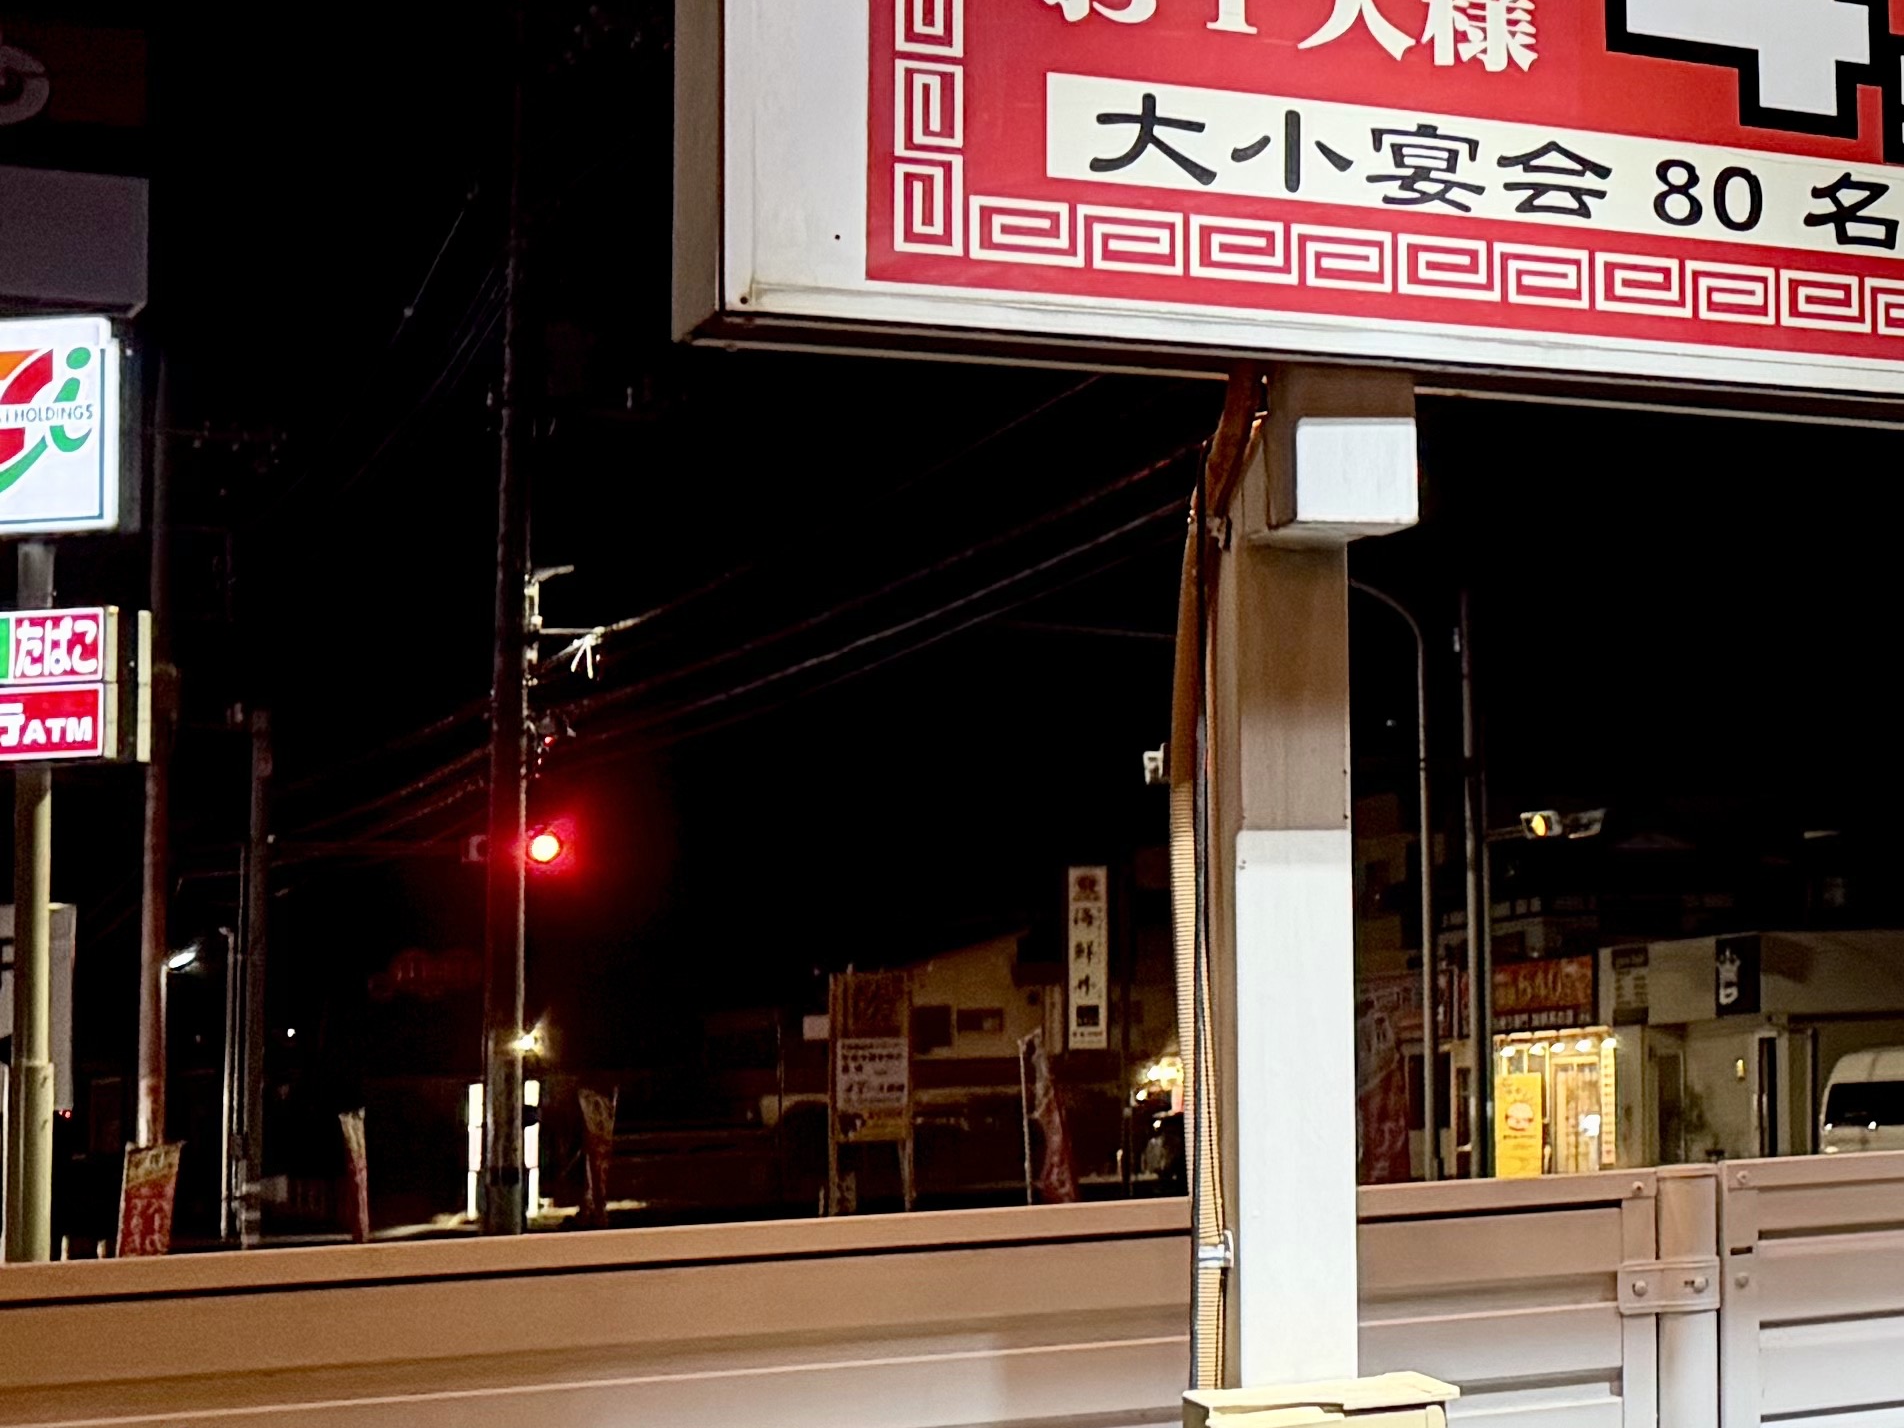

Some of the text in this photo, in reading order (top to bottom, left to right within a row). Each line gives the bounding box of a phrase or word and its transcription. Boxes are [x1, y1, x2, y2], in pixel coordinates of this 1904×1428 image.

[14, 404, 93, 423] HOLDINGS
[15, 616, 98, 678] たばこ
